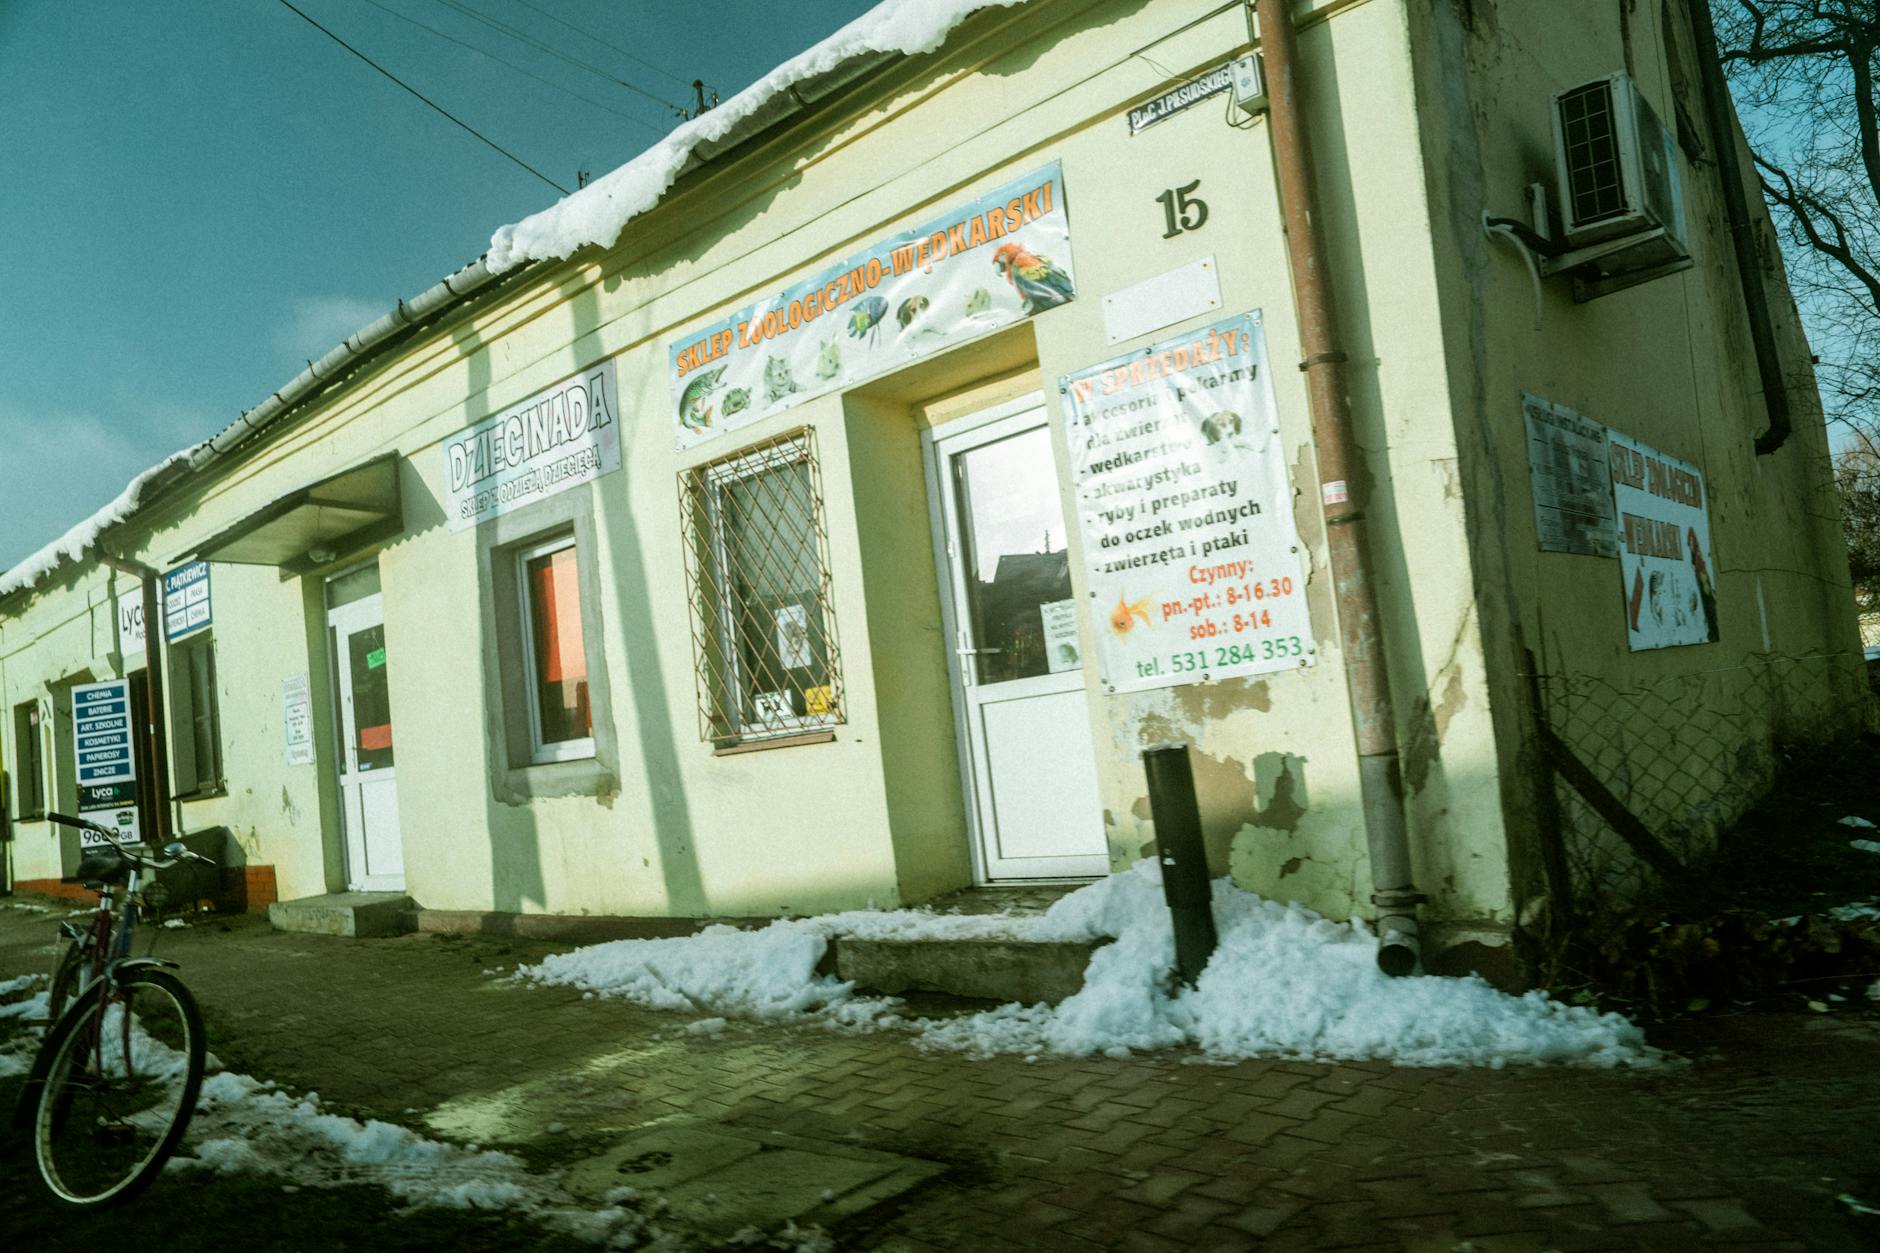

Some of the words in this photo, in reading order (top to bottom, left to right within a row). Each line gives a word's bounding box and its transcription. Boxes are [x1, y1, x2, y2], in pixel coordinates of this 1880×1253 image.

[1155, 179, 1208, 239] 15
[676, 327, 732, 377] SKLEP
[737, 182, 1053, 350] ZOOLOGICZNO-WĘDKARSKI
[1101, 328, 1250, 397] SPRZEDAŻY:
[1176, 363, 1258, 402] pkarmy
[448, 371, 612, 493] DZIECINADA
[461, 490, 490, 519] SKLEP
[1152, 480, 1238, 515] preparaty
[1100, 533, 1120, 549] do
[1125, 520, 1174, 543] oczek
[1178, 499, 1262, 531] wodnych
[1104, 547, 1186, 573] zwierzęta
[1190, 540, 1197, 556] i
[1202, 528, 1249, 558] ptaki
[1189, 559, 1255, 585] Czynny:
[1226, 576, 1292, 605] 8-16.30
[1233, 609, 1272, 633] 8-14
[1136, 657, 1166, 677] tel.
[1171, 651, 1209, 672] 531
[1215, 643, 1256, 666] 284
[1261, 636, 1302, 660] 353
[86, 690, 112, 701] CHEMIA
[88, 704, 112, 716] BATERIE
[80, 723, 94, 732] ART.
[94, 719, 124, 730] SZKOLNE
[84, 734, 121, 746] KOSMETYKI
[86, 750, 121, 762] PAPIEROSY
[93, 766, 116, 777] ZNICZE
[92, 787, 113, 799] Lyca
